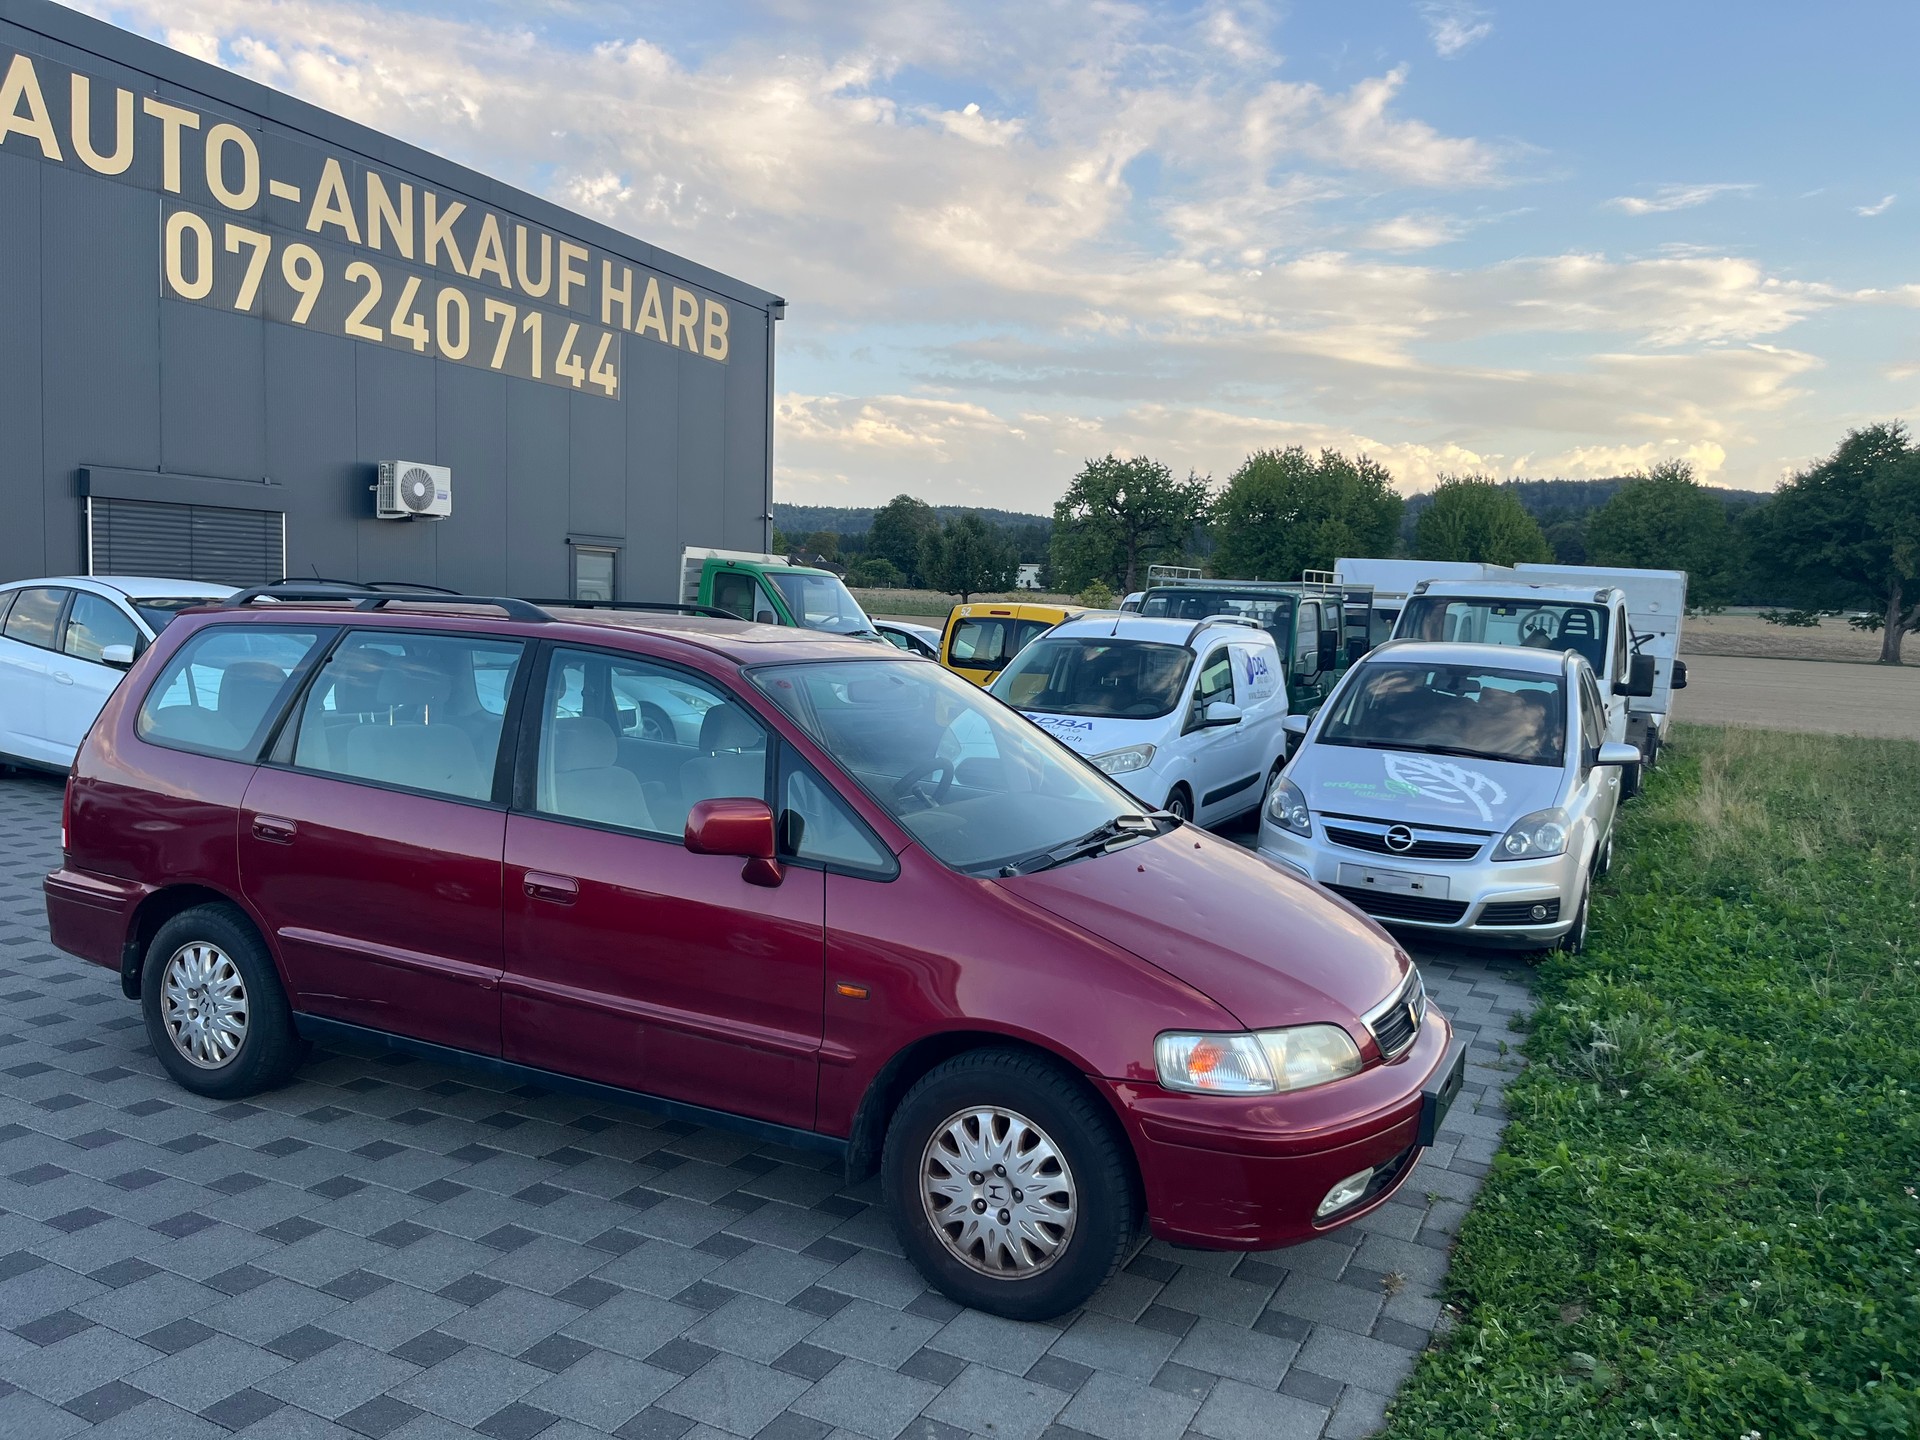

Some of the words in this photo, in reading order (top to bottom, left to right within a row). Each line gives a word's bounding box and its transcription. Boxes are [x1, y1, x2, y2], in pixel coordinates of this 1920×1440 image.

[0, 53, 589, 307] AUTO-ANKAUF
[601, 259, 729, 361] HARB
[165, 211, 324, 324] 079
[344, 261, 470, 360] 240
[1036, 717, 1093, 731] DBA
[1322, 781, 1377, 790] erdgas
